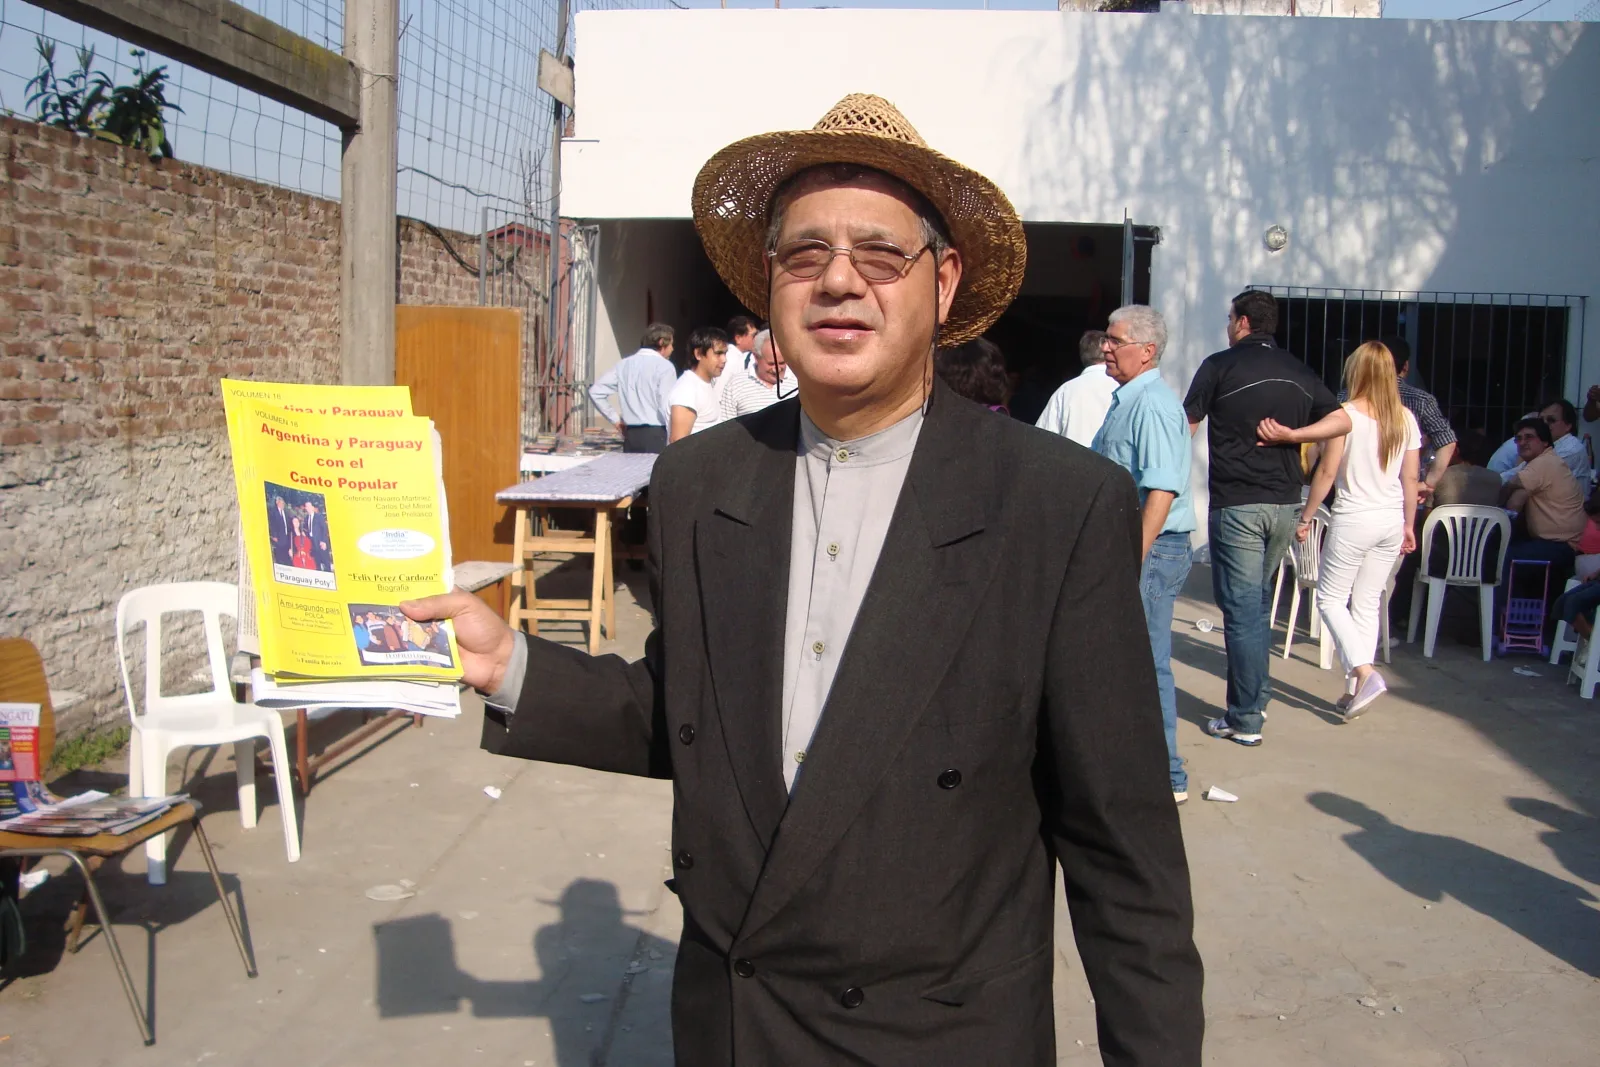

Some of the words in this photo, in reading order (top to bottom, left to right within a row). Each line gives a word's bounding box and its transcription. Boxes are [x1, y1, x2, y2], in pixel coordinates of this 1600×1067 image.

[230, 389, 270, 400] VOLUMEN
[254, 409, 288, 425] VOLUMEN
[261, 422, 330, 447] Argentina
[335, 438, 344, 450] y
[349, 437, 423, 451] Paraguay
[316, 458, 345, 469] con
[350, 457, 364, 469] el
[290, 471, 333, 488] Canto
[338, 477, 398, 492] Popular
[296, 602, 325, 612] segundo
